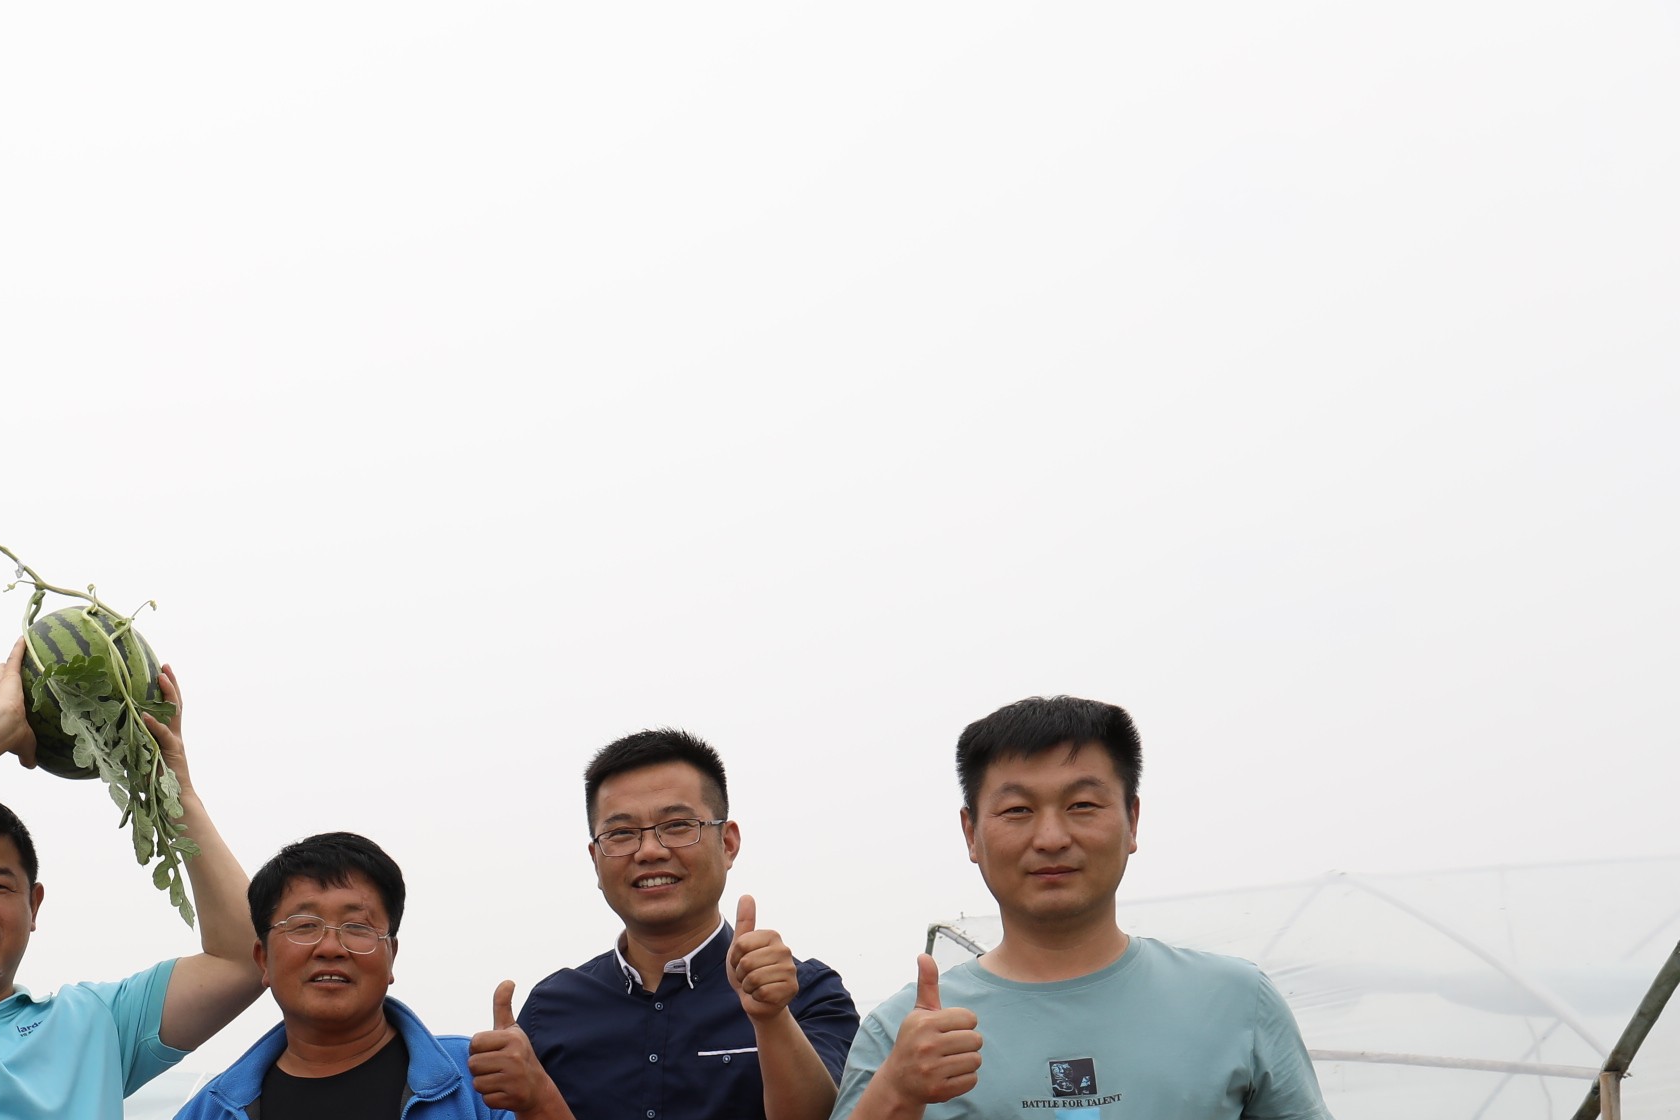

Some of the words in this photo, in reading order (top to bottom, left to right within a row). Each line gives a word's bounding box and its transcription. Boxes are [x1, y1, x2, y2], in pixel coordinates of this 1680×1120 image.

[1022, 1100, 1059, 1109] BATTLE
[1062, 1099, 1083, 1108] FOR
[1085, 1093, 1122, 1107] TALENT
